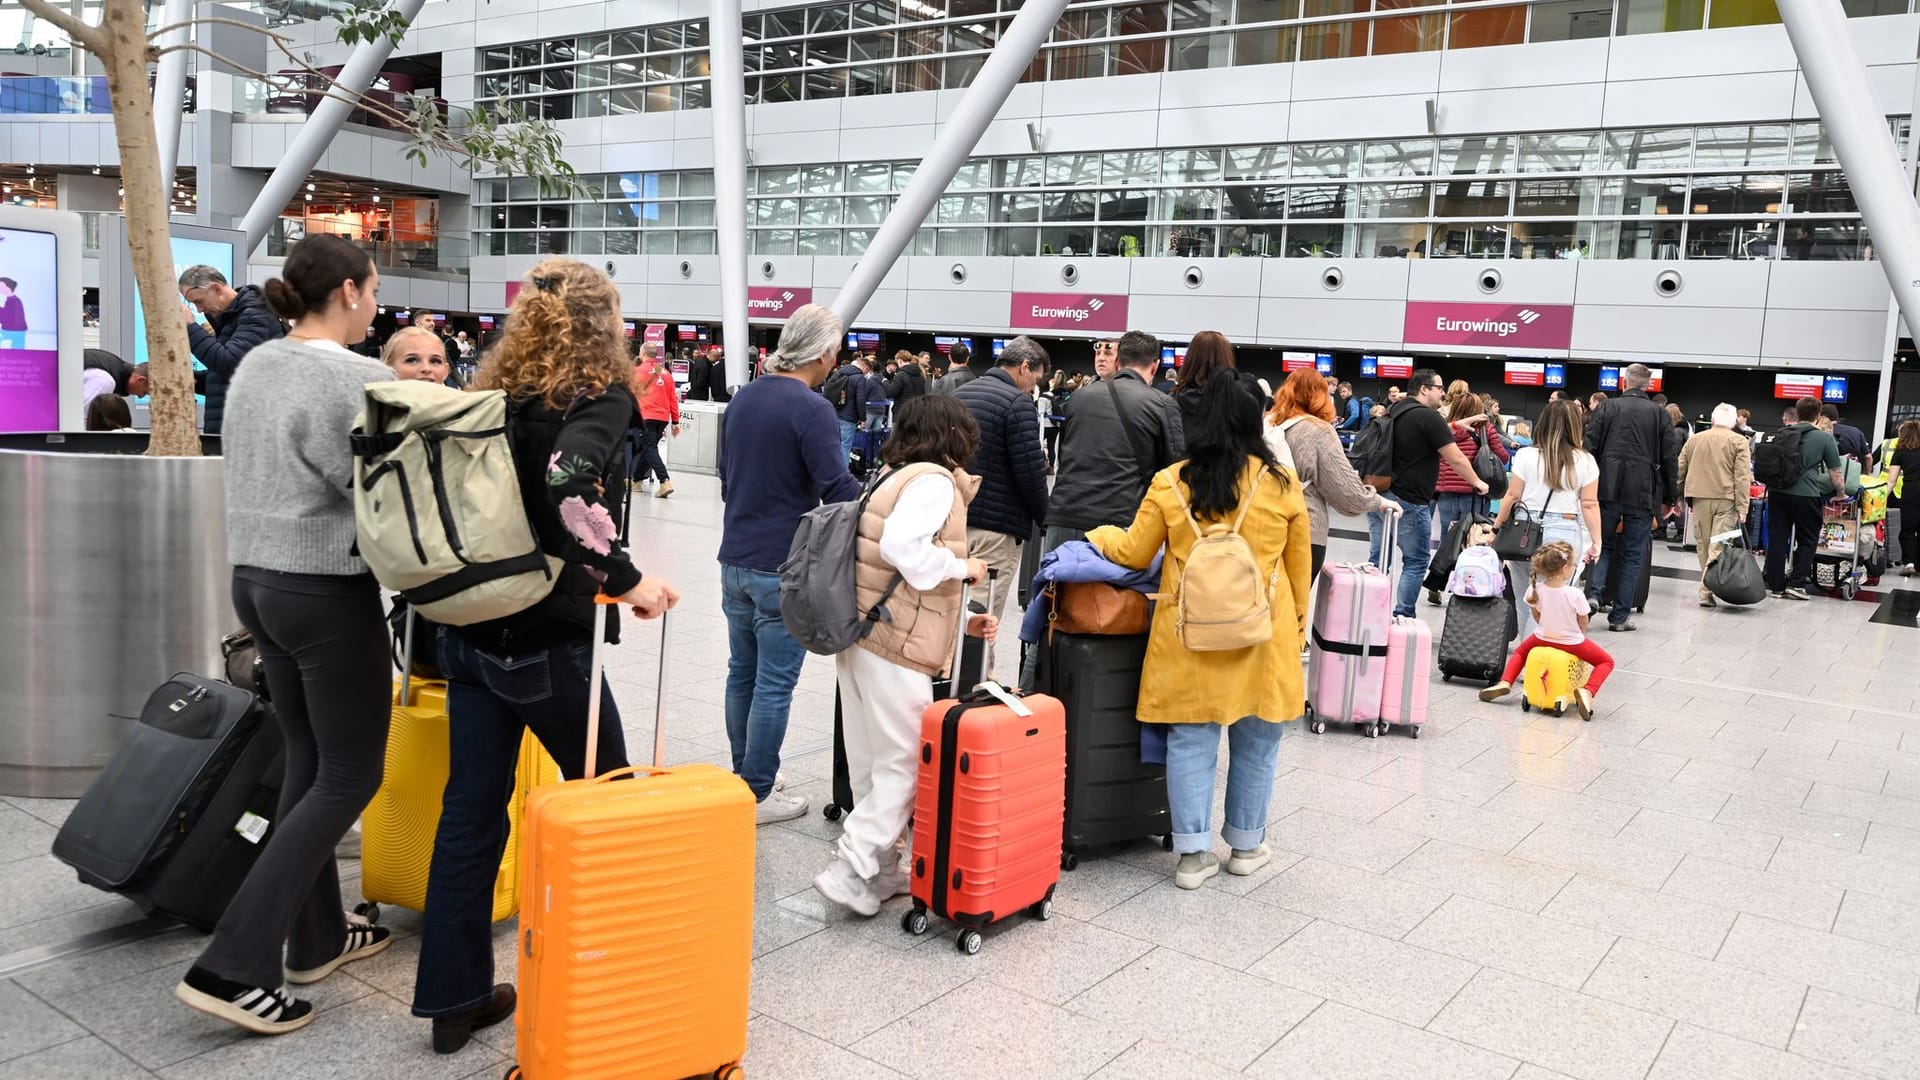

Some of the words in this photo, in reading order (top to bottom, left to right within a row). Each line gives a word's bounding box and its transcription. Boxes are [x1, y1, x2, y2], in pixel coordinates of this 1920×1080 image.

[1032, 305, 1089, 322] Eurowings
[1436, 317, 1518, 337] Eurowings
[1601, 378, 1618, 387] 152
[1825, 389, 1844, 399] 151
